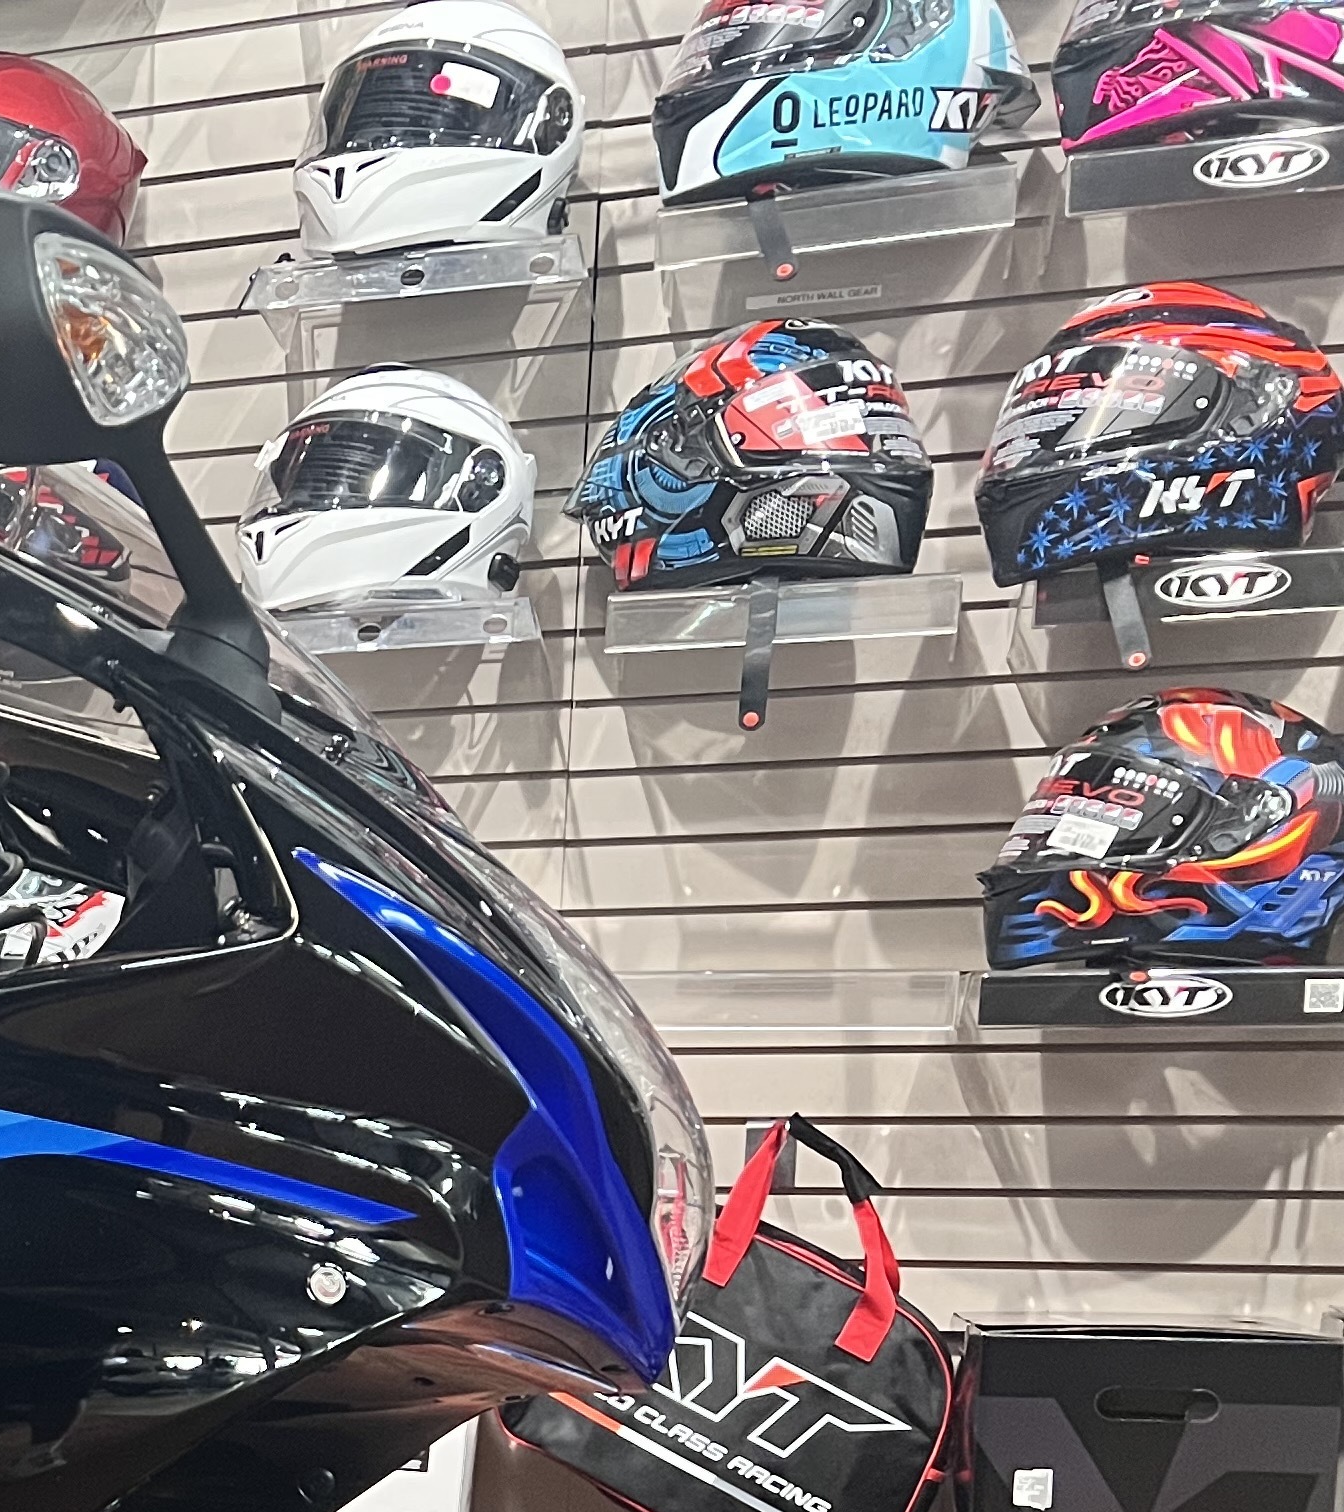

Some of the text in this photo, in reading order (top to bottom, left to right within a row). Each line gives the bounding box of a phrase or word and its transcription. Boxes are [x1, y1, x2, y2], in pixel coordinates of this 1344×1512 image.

[813, 87, 925, 128] LEOPARD
[1214, 150, 1310, 179] KYT
[777, 286, 880, 305] NORTH WALL GEAR
[1140, 469, 1255, 517] KYT
[594, 507, 644, 543] KYT
[1175, 570, 1272, 599] KYT
[1119, 983, 1211, 1010] KYT
[633, 1405, 730, 1463] CLASS
